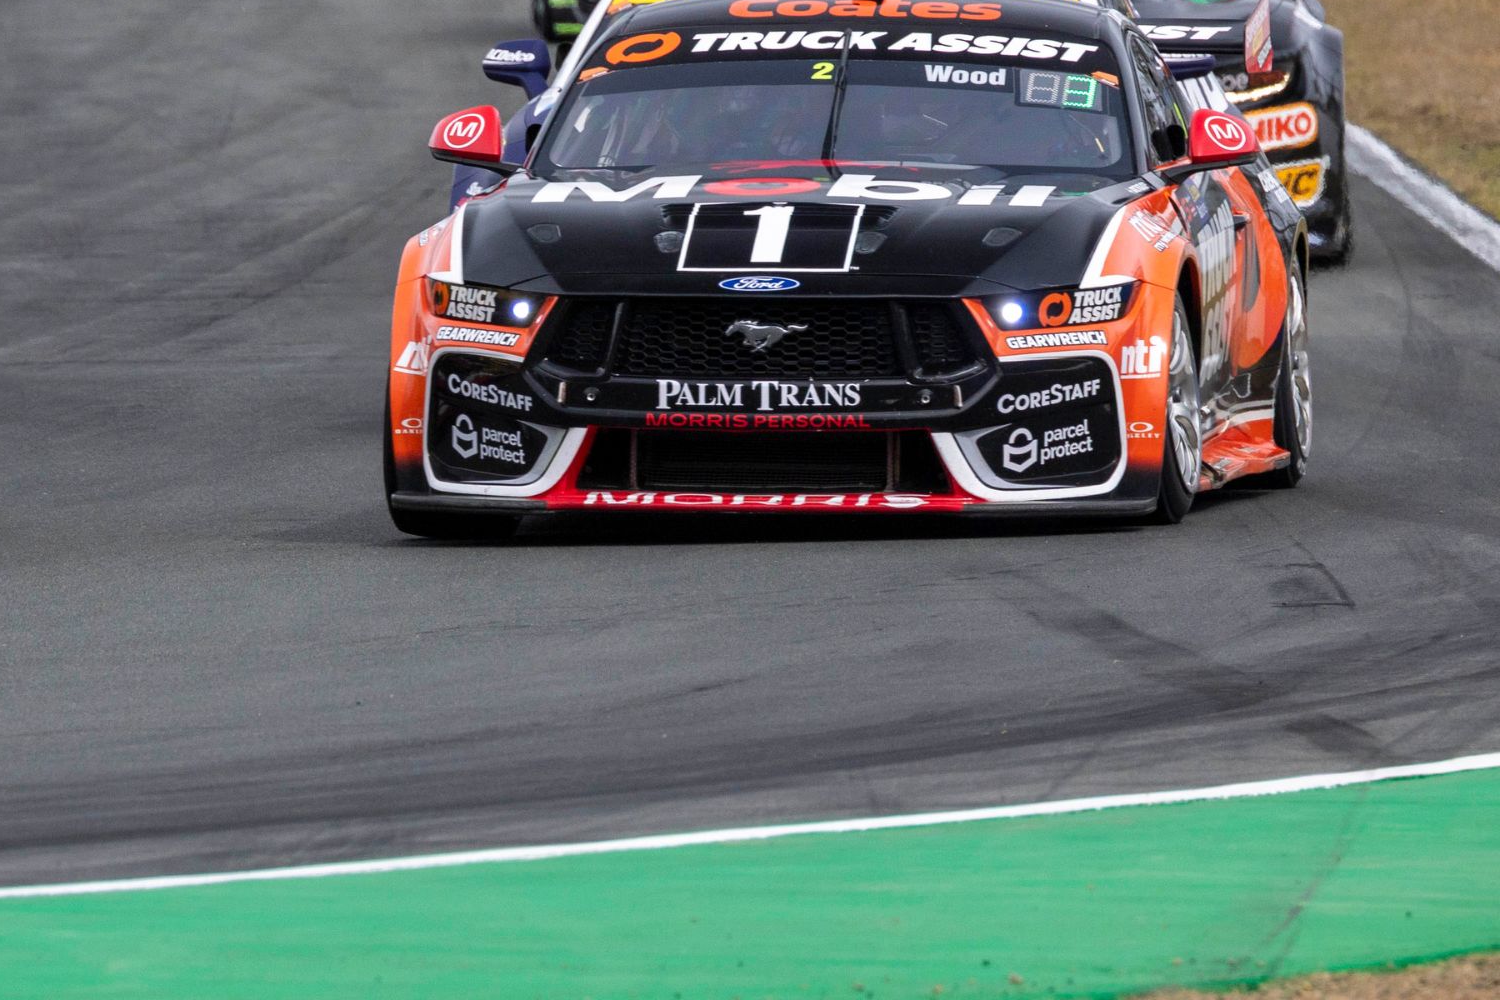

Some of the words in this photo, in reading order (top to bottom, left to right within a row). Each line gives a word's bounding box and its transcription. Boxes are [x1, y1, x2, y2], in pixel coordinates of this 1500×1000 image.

[728, 0, 1002, 20] Coates
[690, 30, 888, 54] TRUCK
[888, 31, 1098, 63] ASSIST
[811, 62, 834, 80] 2
[924, 64, 1006, 86] Wood
[531, 173, 1058, 207] Mobil
[744, 203, 795, 264] 1
[449, 284, 498, 307] TRUCK
[732, 276, 786, 292] Ford
[1074, 286, 1122, 307] TRUCK
[446, 300, 496, 323] ASSIST
[1067, 303, 1121, 324] ASSIST
[436, 326, 521, 347] GEARWRENCH
[1005, 330, 1108, 349] GEARWRENCH
[656, 378, 744, 410] PALM
[752, 379, 862, 411] TRANS
[645, 412, 748, 428] MORRIS
[754, 414, 871, 429] PERSONAL
[481, 427, 522, 448] parcel
[1043, 419, 1090, 446] parcel
[479, 441, 527, 465] protect
[1040, 436, 1094, 466] protect
[583, 490, 933, 510] MORRIS
